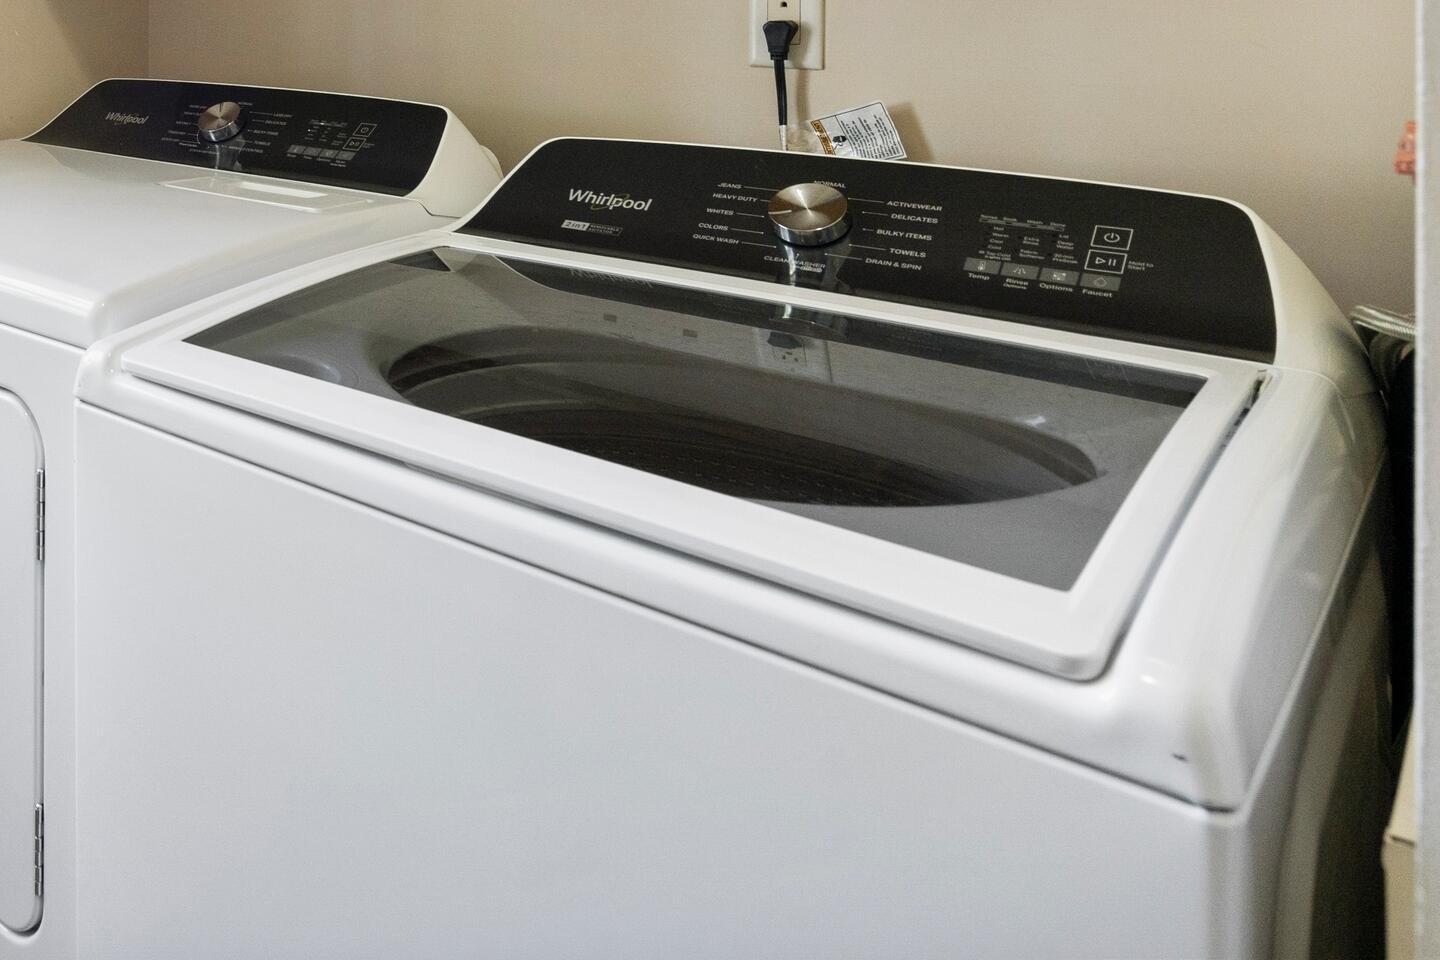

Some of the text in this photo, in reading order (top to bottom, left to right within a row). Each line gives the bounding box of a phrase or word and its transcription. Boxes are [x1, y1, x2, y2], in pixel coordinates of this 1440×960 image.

[105, 112, 150, 125] Whirlpool
[718, 182, 742, 190] JEANS
[568, 188, 653, 211] Whirlpool
[712, 193, 758, 203] HEAVY DUTY
[706, 207, 734, 216] WHITES
[886, 200, 943, 212] ACTIVEWEAR
[891, 213, 939, 224] DELICATES
[698, 222, 729, 232] COLORS
[693, 233, 739, 245] QUICK WASH
[876, 228, 933, 242] BULKY ITEMS
[889, 247, 927, 258] TOWELS
[763, 255, 790, 265] CLEAN
[792, 257, 826, 269] WASHER
[865, 257, 922, 271] DRAIN & SPIN
[968, 273, 990, 281] Temp
[1006, 278, 1029, 286] Rinse
[1040, 282, 1073, 293] Options
[1082, 288, 1113, 298] Faucet
